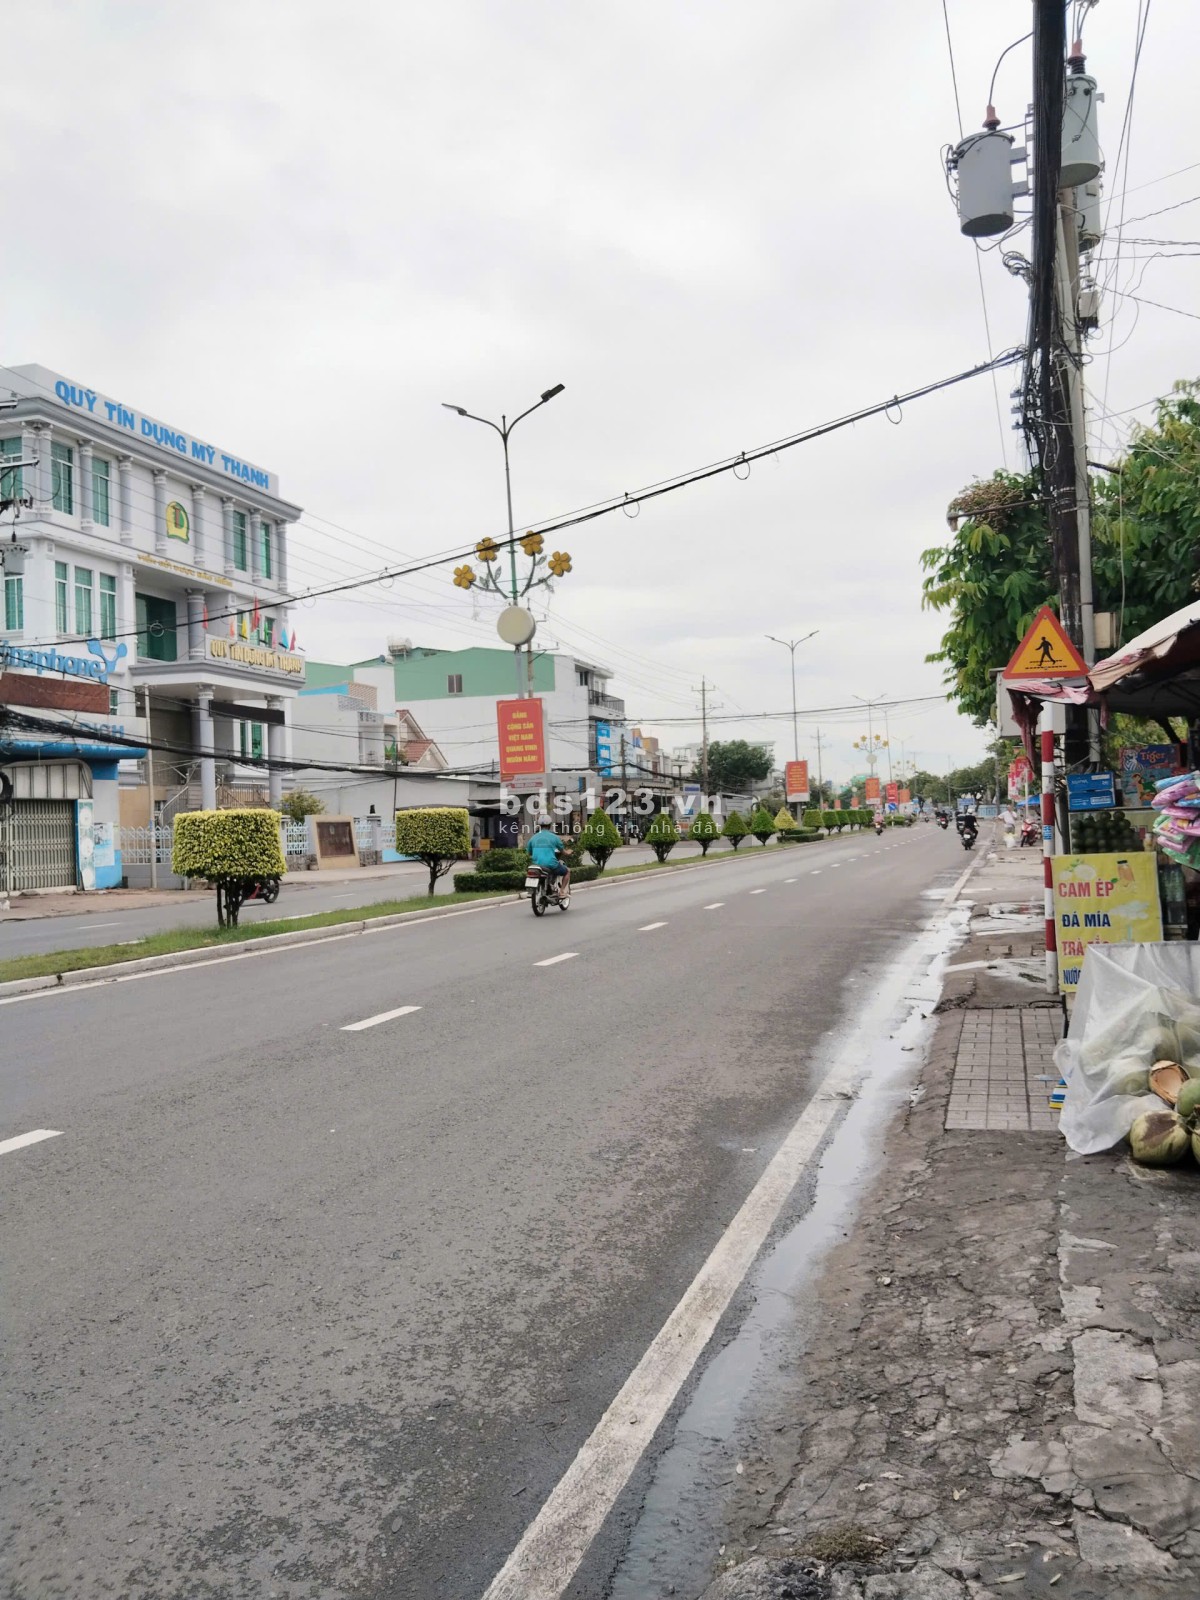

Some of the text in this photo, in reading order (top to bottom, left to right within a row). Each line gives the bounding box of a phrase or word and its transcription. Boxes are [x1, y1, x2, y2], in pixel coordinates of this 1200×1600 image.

[55, 380, 269, 489] QUỸ TÍN DỤNG MỸ THẠNH
[1140, 751, 1165, 763] Tiger
[1058, 881, 1091, 898] CAM
[1061, 911, 1111, 928] ĐÁ MÍA
[1061, 938, 1085, 956] TRÀ
